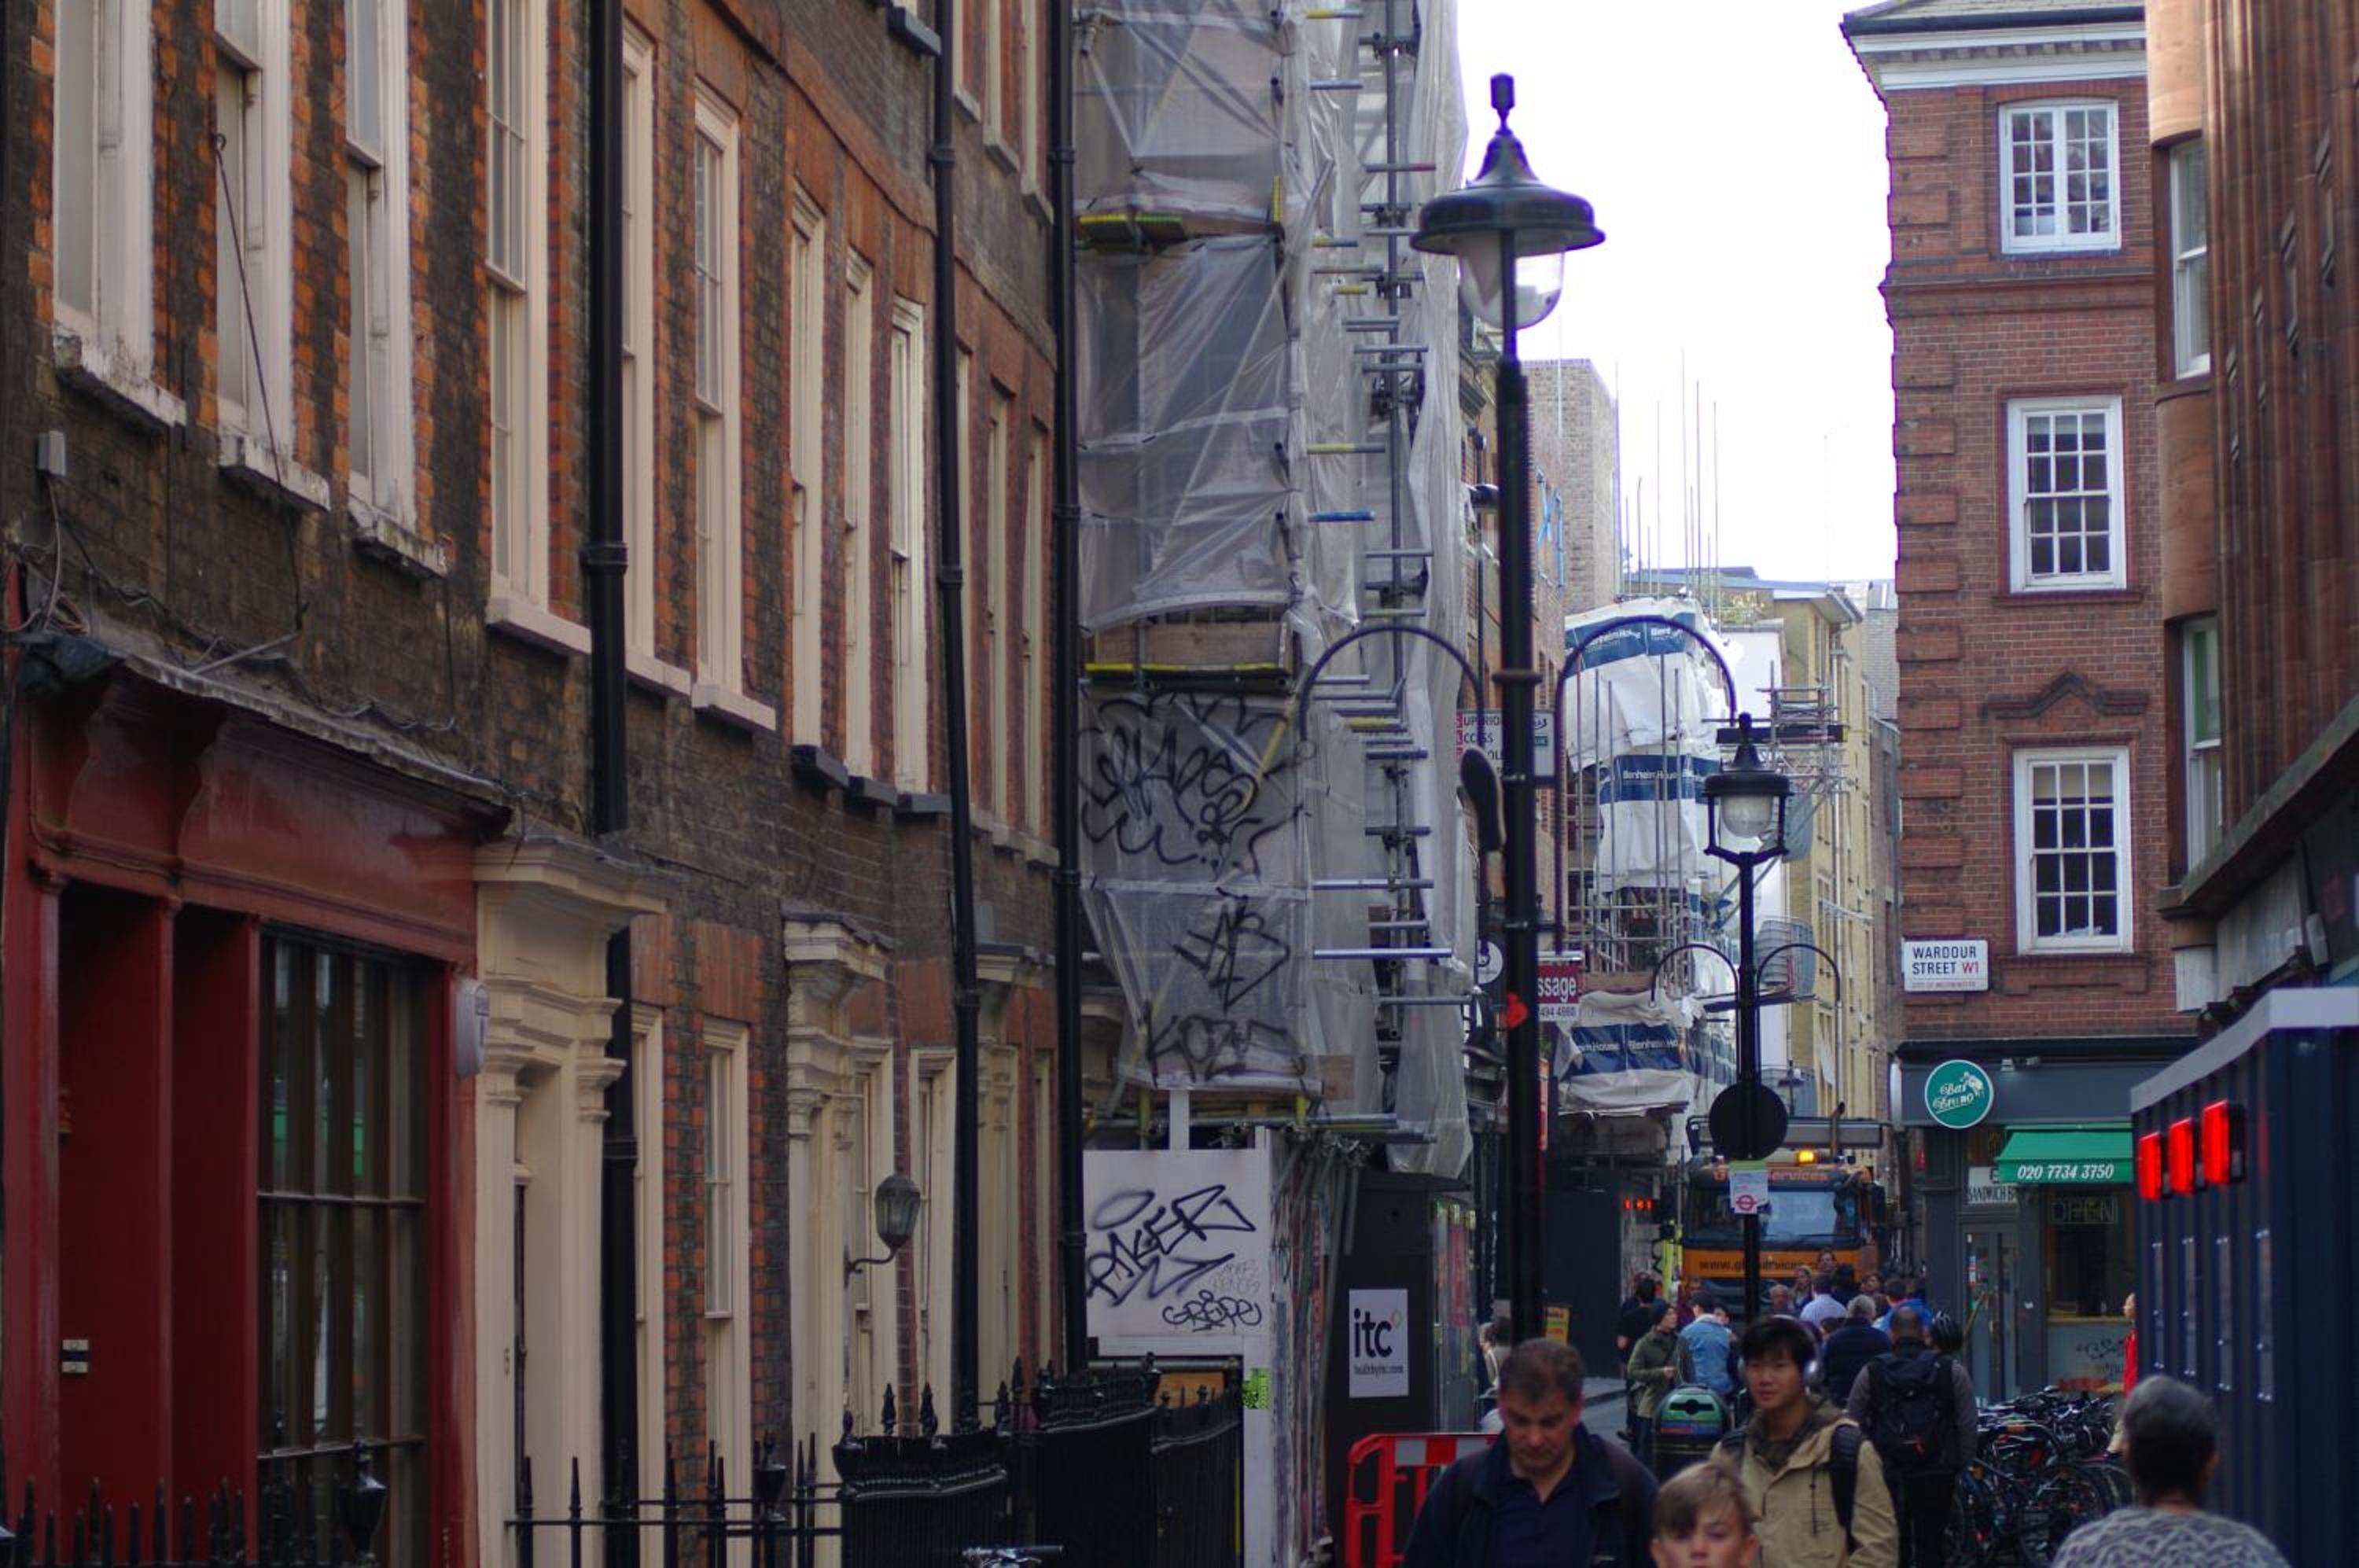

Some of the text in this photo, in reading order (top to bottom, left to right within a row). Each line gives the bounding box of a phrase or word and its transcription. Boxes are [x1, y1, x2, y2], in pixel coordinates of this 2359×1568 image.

[1912, 946, 1976, 959] WARDOUR
[1912, 961, 1978, 974] STREET W1
[2017, 1164, 2114, 1179] 020 7734 3750
[1354, 1308, 1392, 1358] itc
